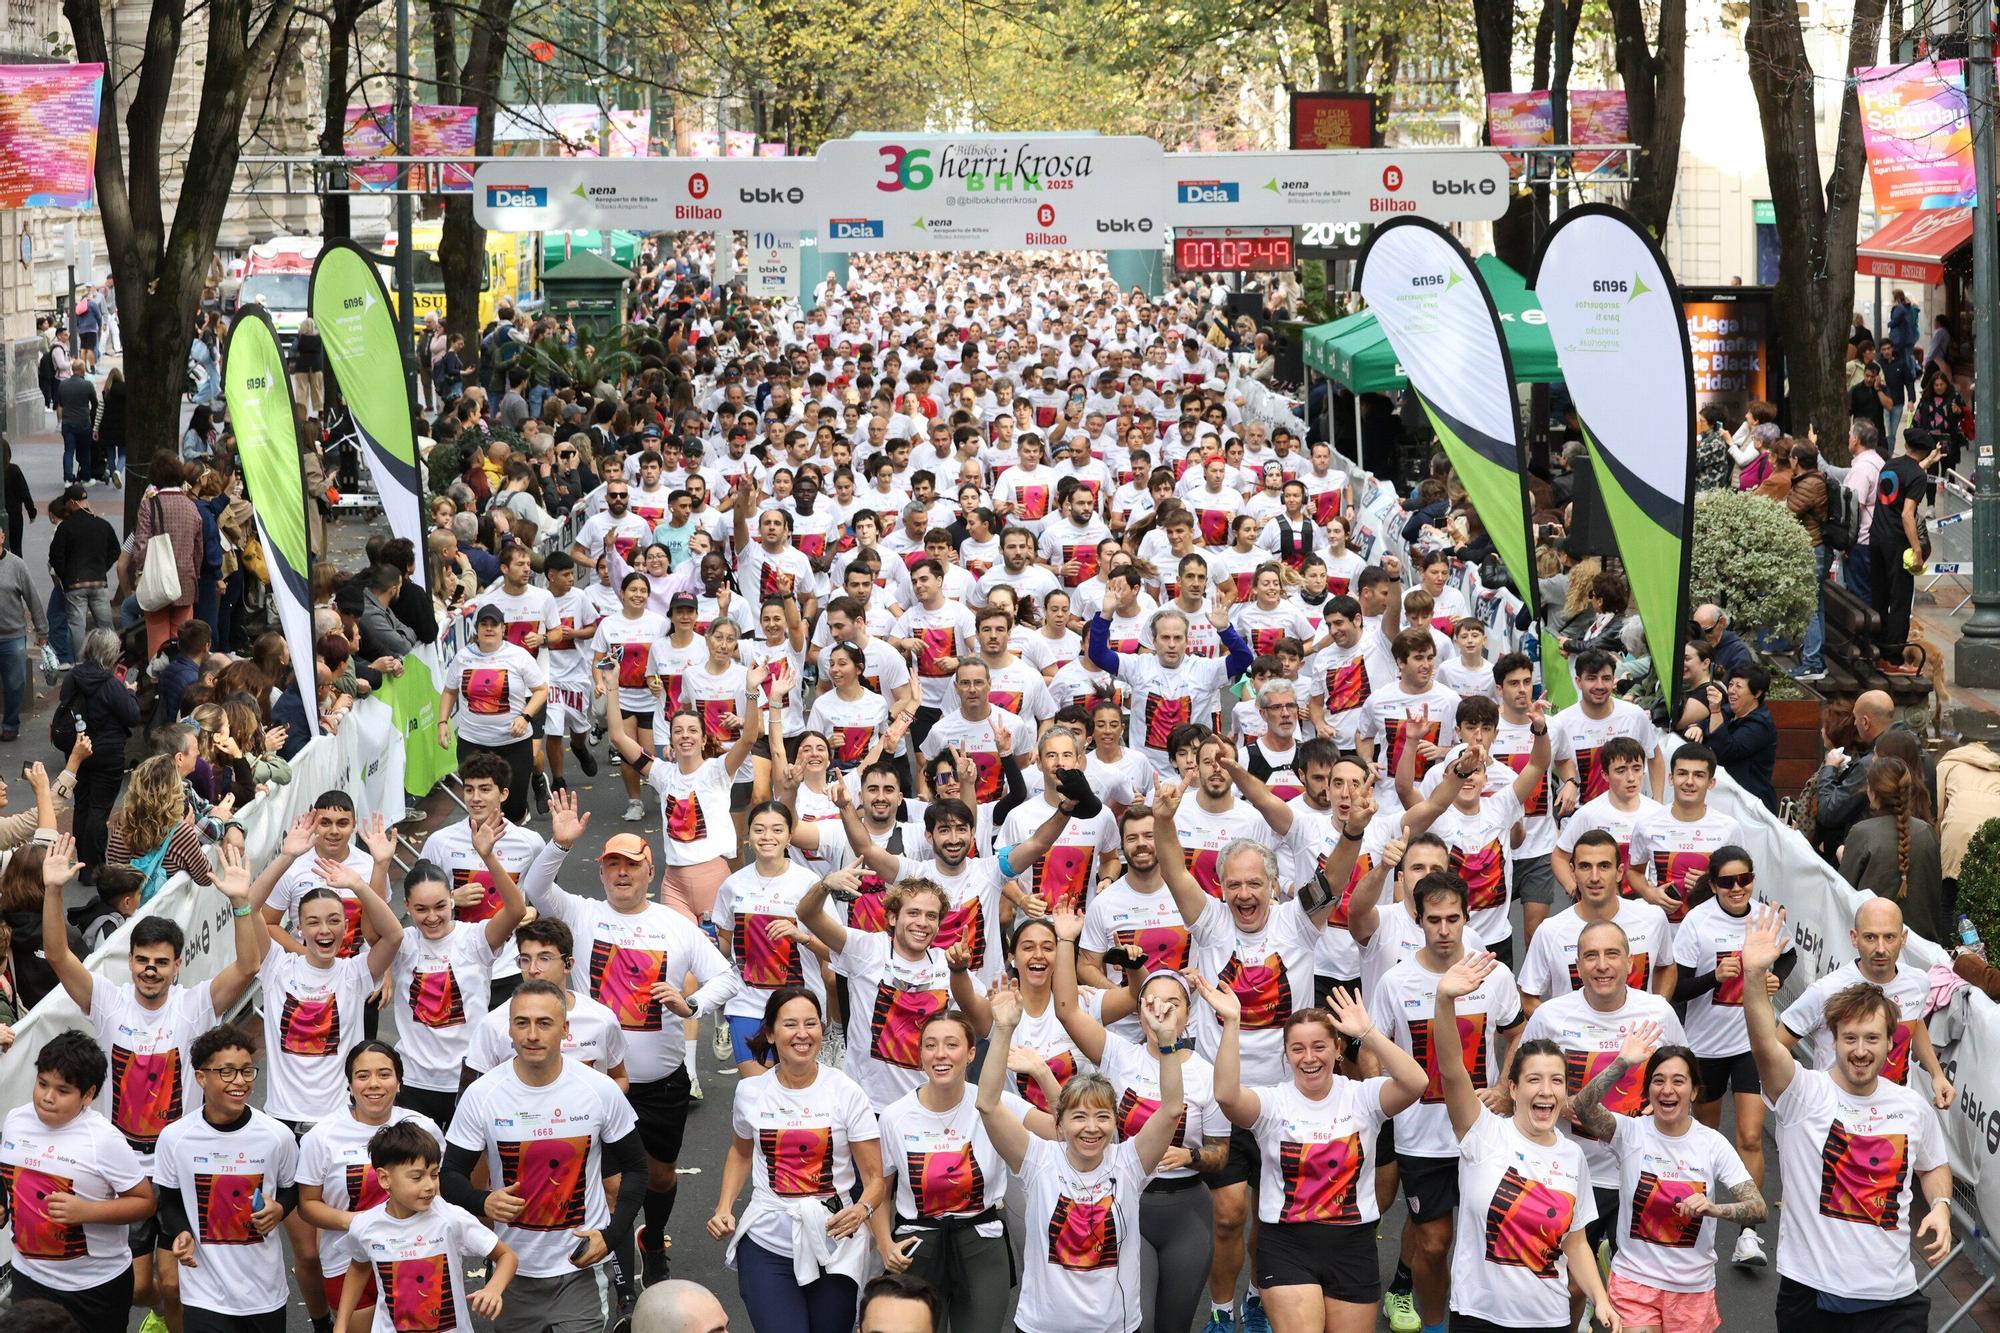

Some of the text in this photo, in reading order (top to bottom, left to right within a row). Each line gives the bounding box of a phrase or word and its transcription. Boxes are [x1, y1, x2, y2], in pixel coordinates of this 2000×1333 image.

[1864, 88, 1903, 110] Fair
[1491, 106, 1514, 117] Fair
[1867, 106, 1965, 130] Saturday
[1492, 117, 1551, 131] Saturday
[955, 144, 997, 156] Bilboko
[876, 145, 934, 192] 36
[589, 186, 616, 195] aena
[1047, 180, 1074, 190] 2025
[1281, 181, 1309, 189] aena
[1433, 180, 1475, 194] bbk
[496, 191, 537, 207] Deia
[740, 188, 784, 203] bbk
[1187, 186, 1229, 202] Deia
[957, 197, 1037, 206] @bilbokoherrikrosa
[1370, 198, 1416, 212] Bilbao
[675, 205, 722, 219] Bilbao
[928, 218, 952, 227] aena
[1096, 219, 1135, 232] bbk
[838, 223, 874, 238] Deia
[754, 232, 794, 249] 10 km.
[1026, 233, 1067, 245] Bilbao
[1184, 241, 1289, 267] 00:02:49
[1712, 354, 1760, 372] Black
[216, 901, 232, 933] bbk
[185, 934, 201, 968] bbk
[1600, 1041, 1619, 1049] 5296
[1961, 1083, 1987, 1133] bbk
[532, 1128, 553, 1137] 1668
